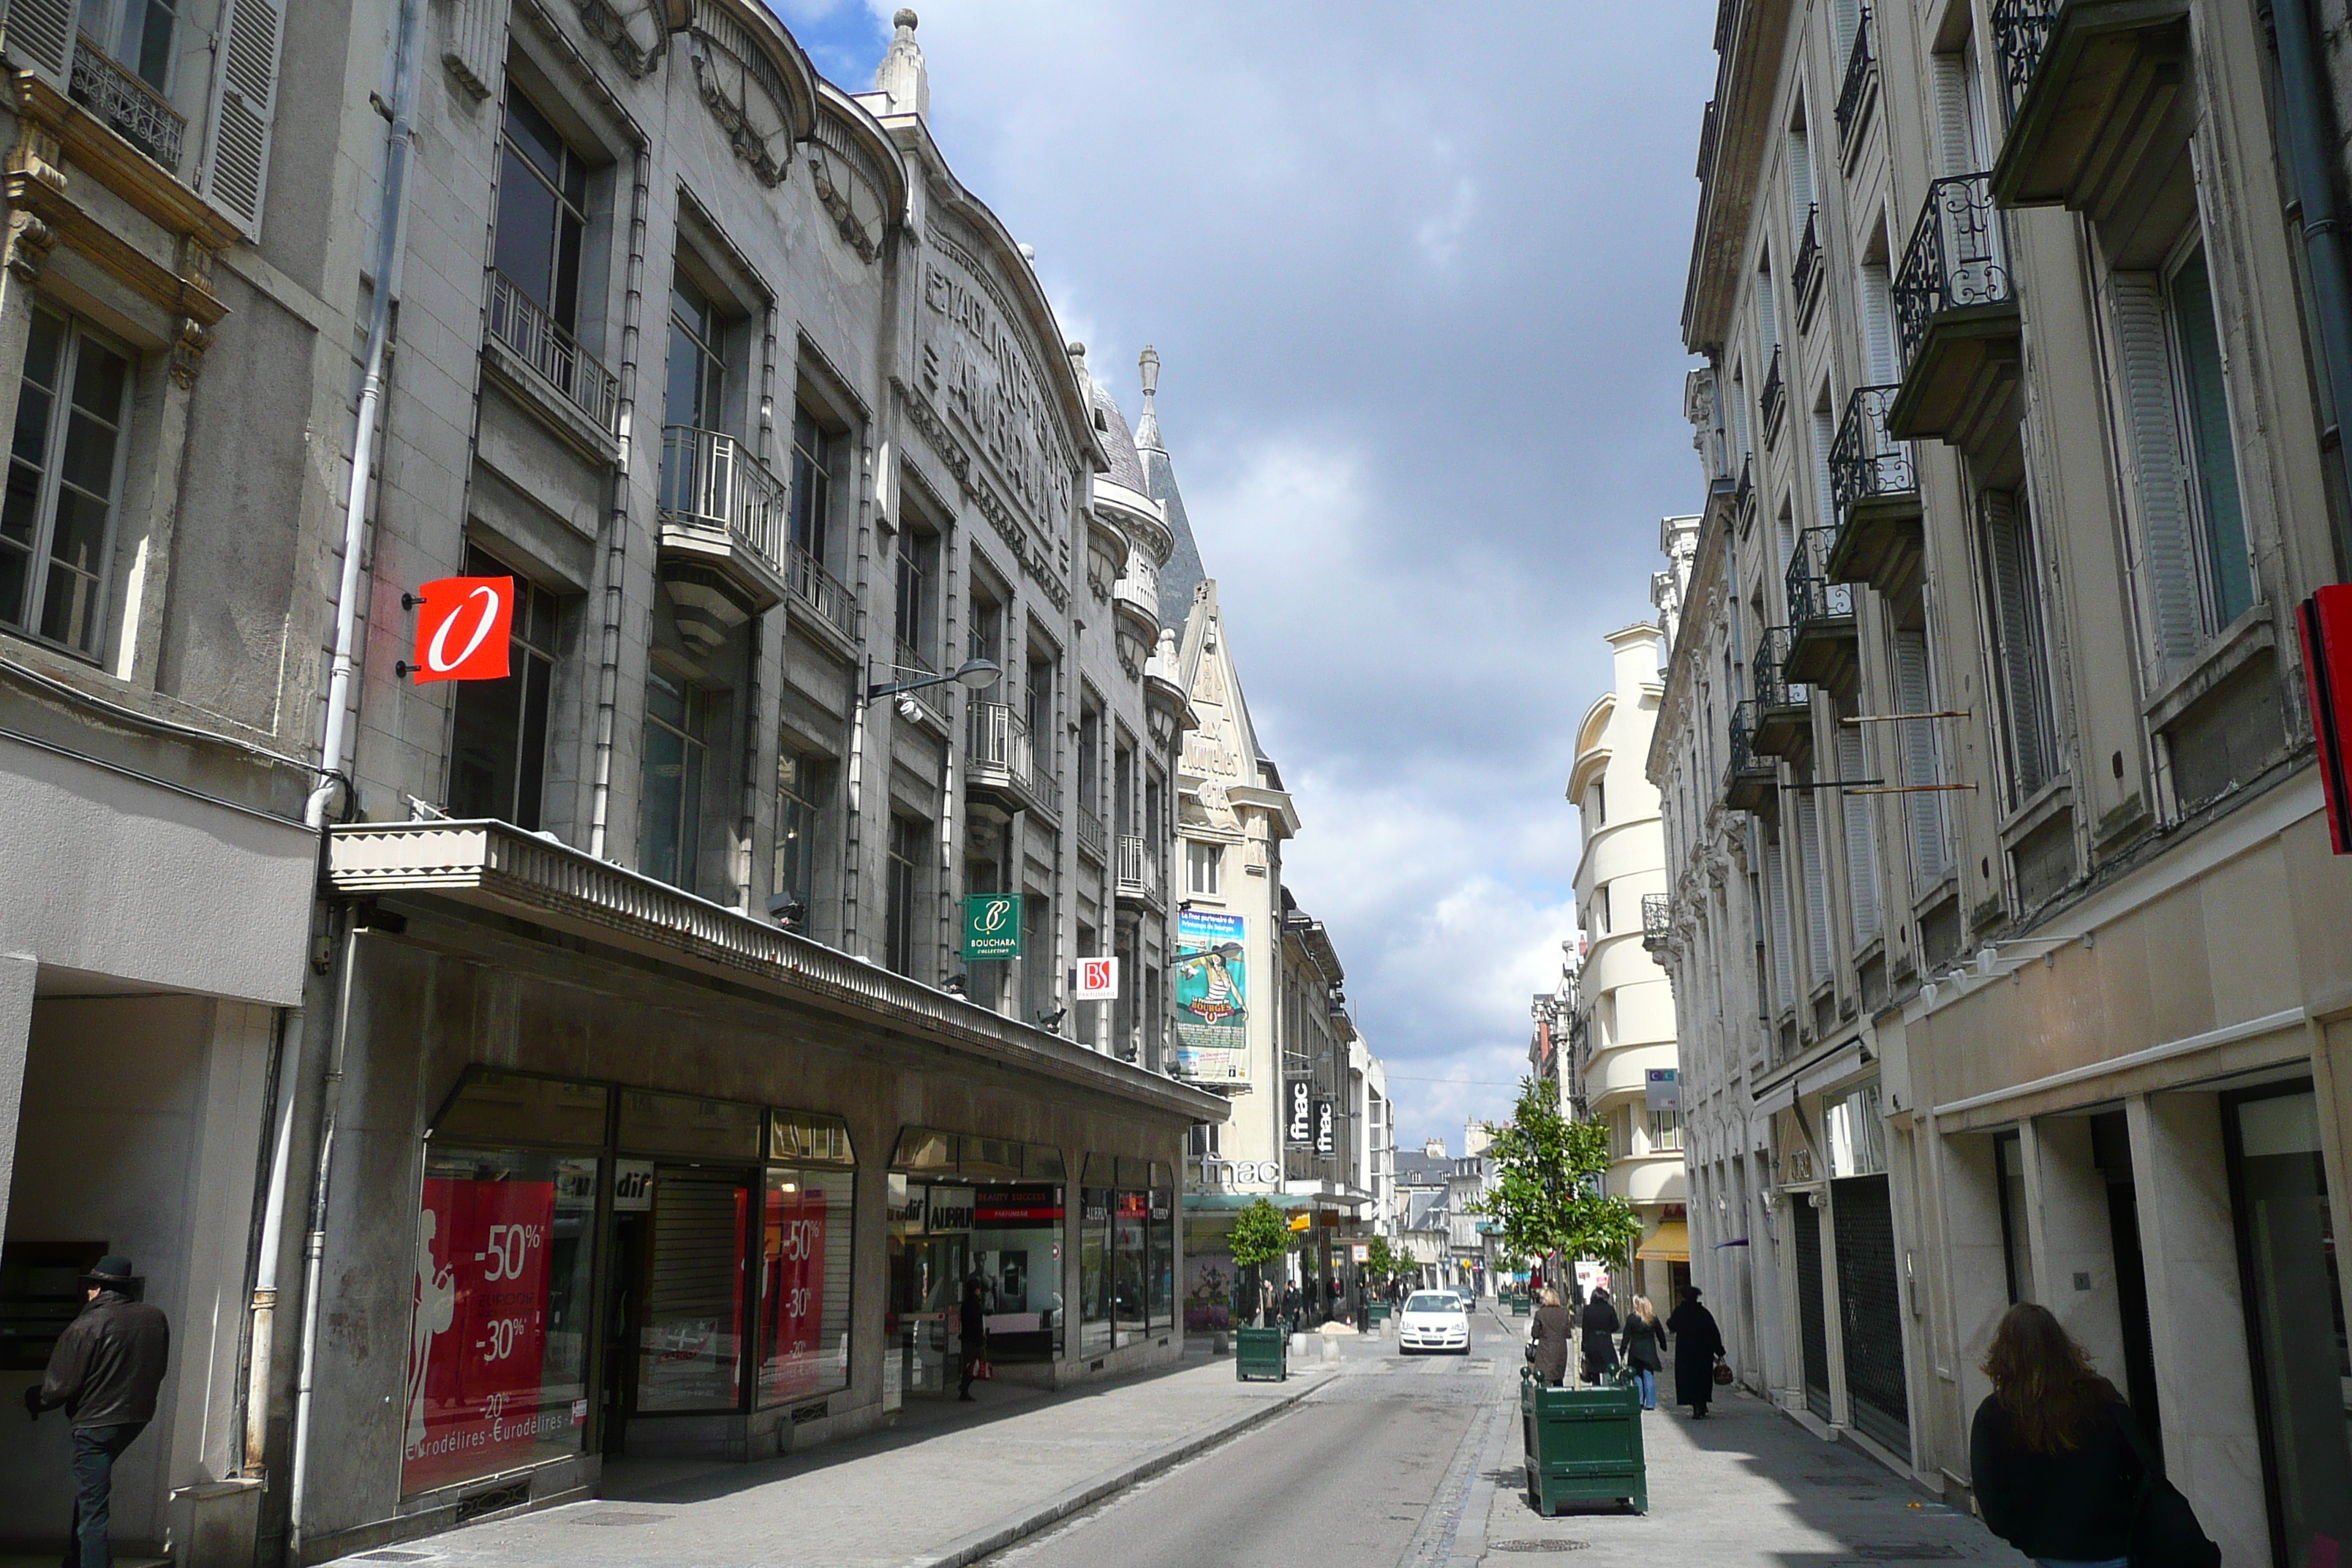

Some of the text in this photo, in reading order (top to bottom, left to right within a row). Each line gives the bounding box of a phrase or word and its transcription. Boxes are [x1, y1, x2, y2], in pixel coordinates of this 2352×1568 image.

[948, 342, 1054, 535] AUBRUN
[971, 939, 1016, 947] BOUCHARA
[1087, 961, 1108, 988] BS
[1191, 1001, 1232, 1012] BOURGES
[1291, 1082, 1308, 1139] fnac
[1317, 1103, 1333, 1151] fnac
[1200, 1151, 1279, 1183] fnac
[978, 1192, 1047, 1202] BEAUTY SUCCESS
